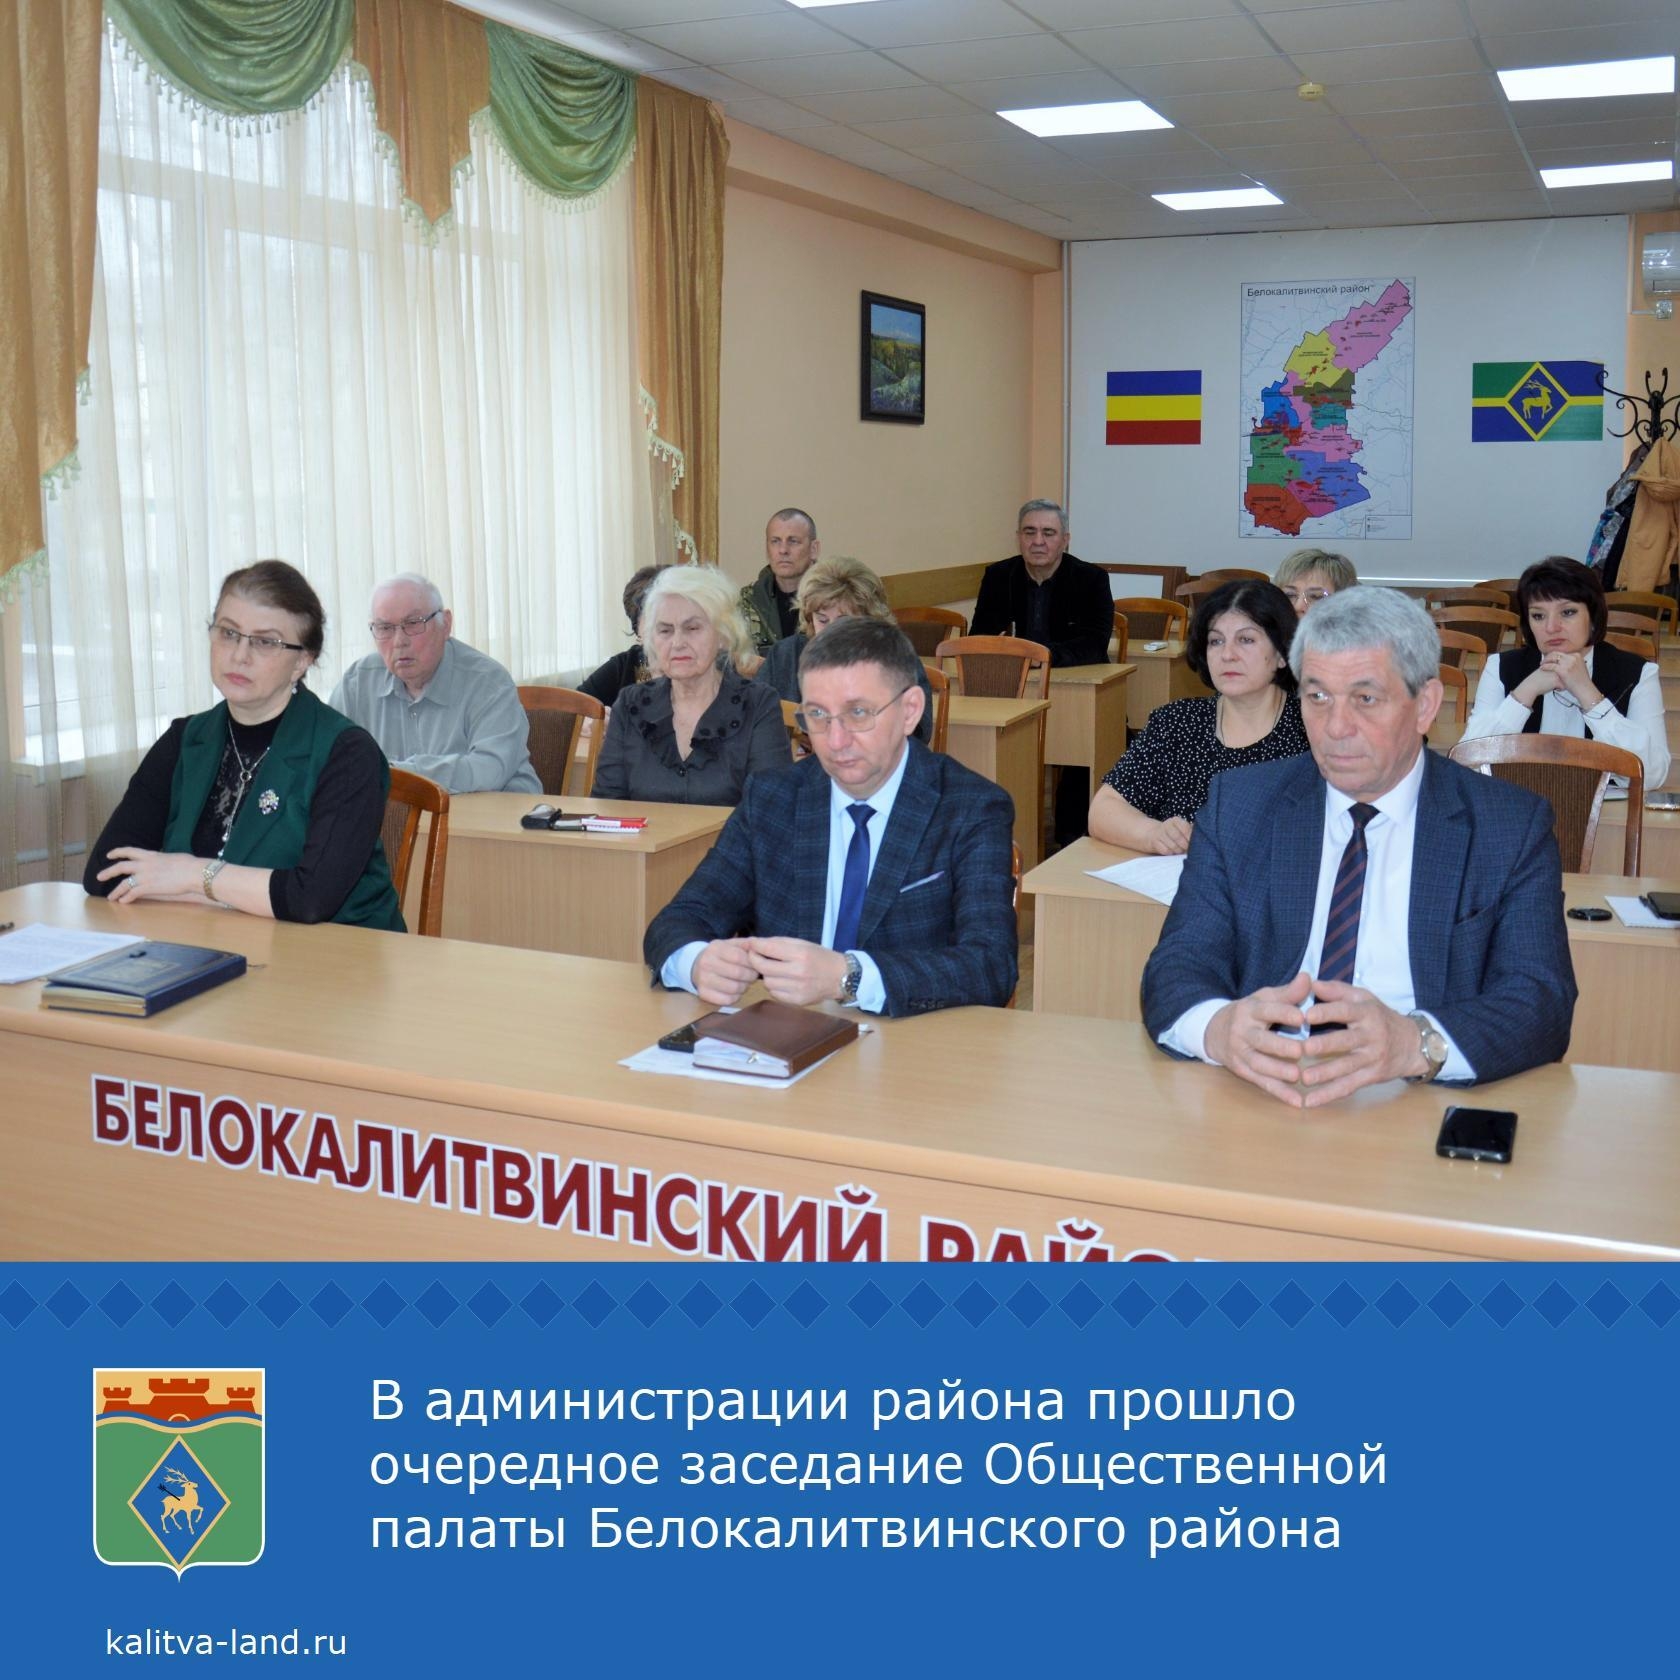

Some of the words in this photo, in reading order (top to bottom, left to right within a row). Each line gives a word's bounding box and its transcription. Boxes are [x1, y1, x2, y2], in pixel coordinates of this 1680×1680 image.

[1246, 284, 1338, 297] Белокалитвинский
[1340, 283, 1370, 295] район
[93, 1075, 887, 1262] БЕЛОКАЛИТВИНСКИЙ
